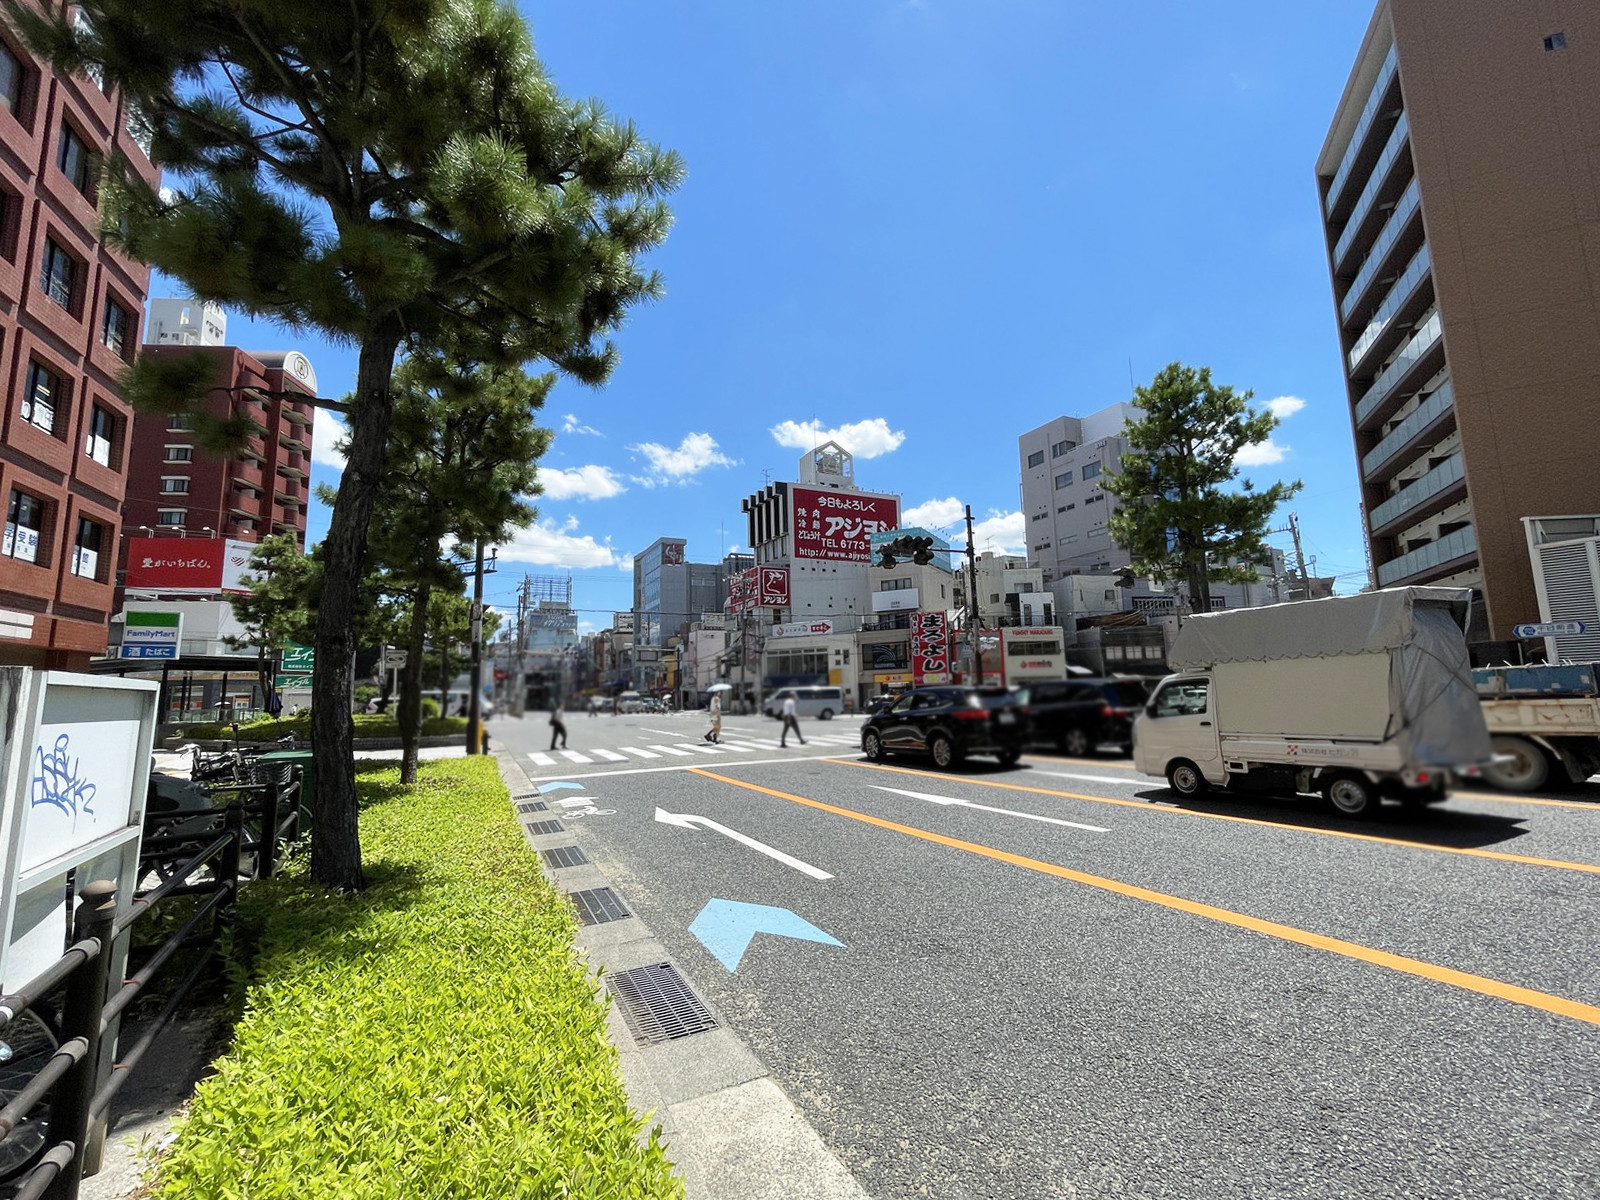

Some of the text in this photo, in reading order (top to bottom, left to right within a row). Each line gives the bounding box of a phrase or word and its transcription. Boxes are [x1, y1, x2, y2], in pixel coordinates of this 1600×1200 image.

[817, 496, 876, 513] 今日もよろしく
[821, 538, 839, 548] TEL
[141, 557, 211, 569] 愛がいちばん。
[126, 629, 175, 639] FamilyMart
[128, 647, 171, 657] 酒 たばこ
